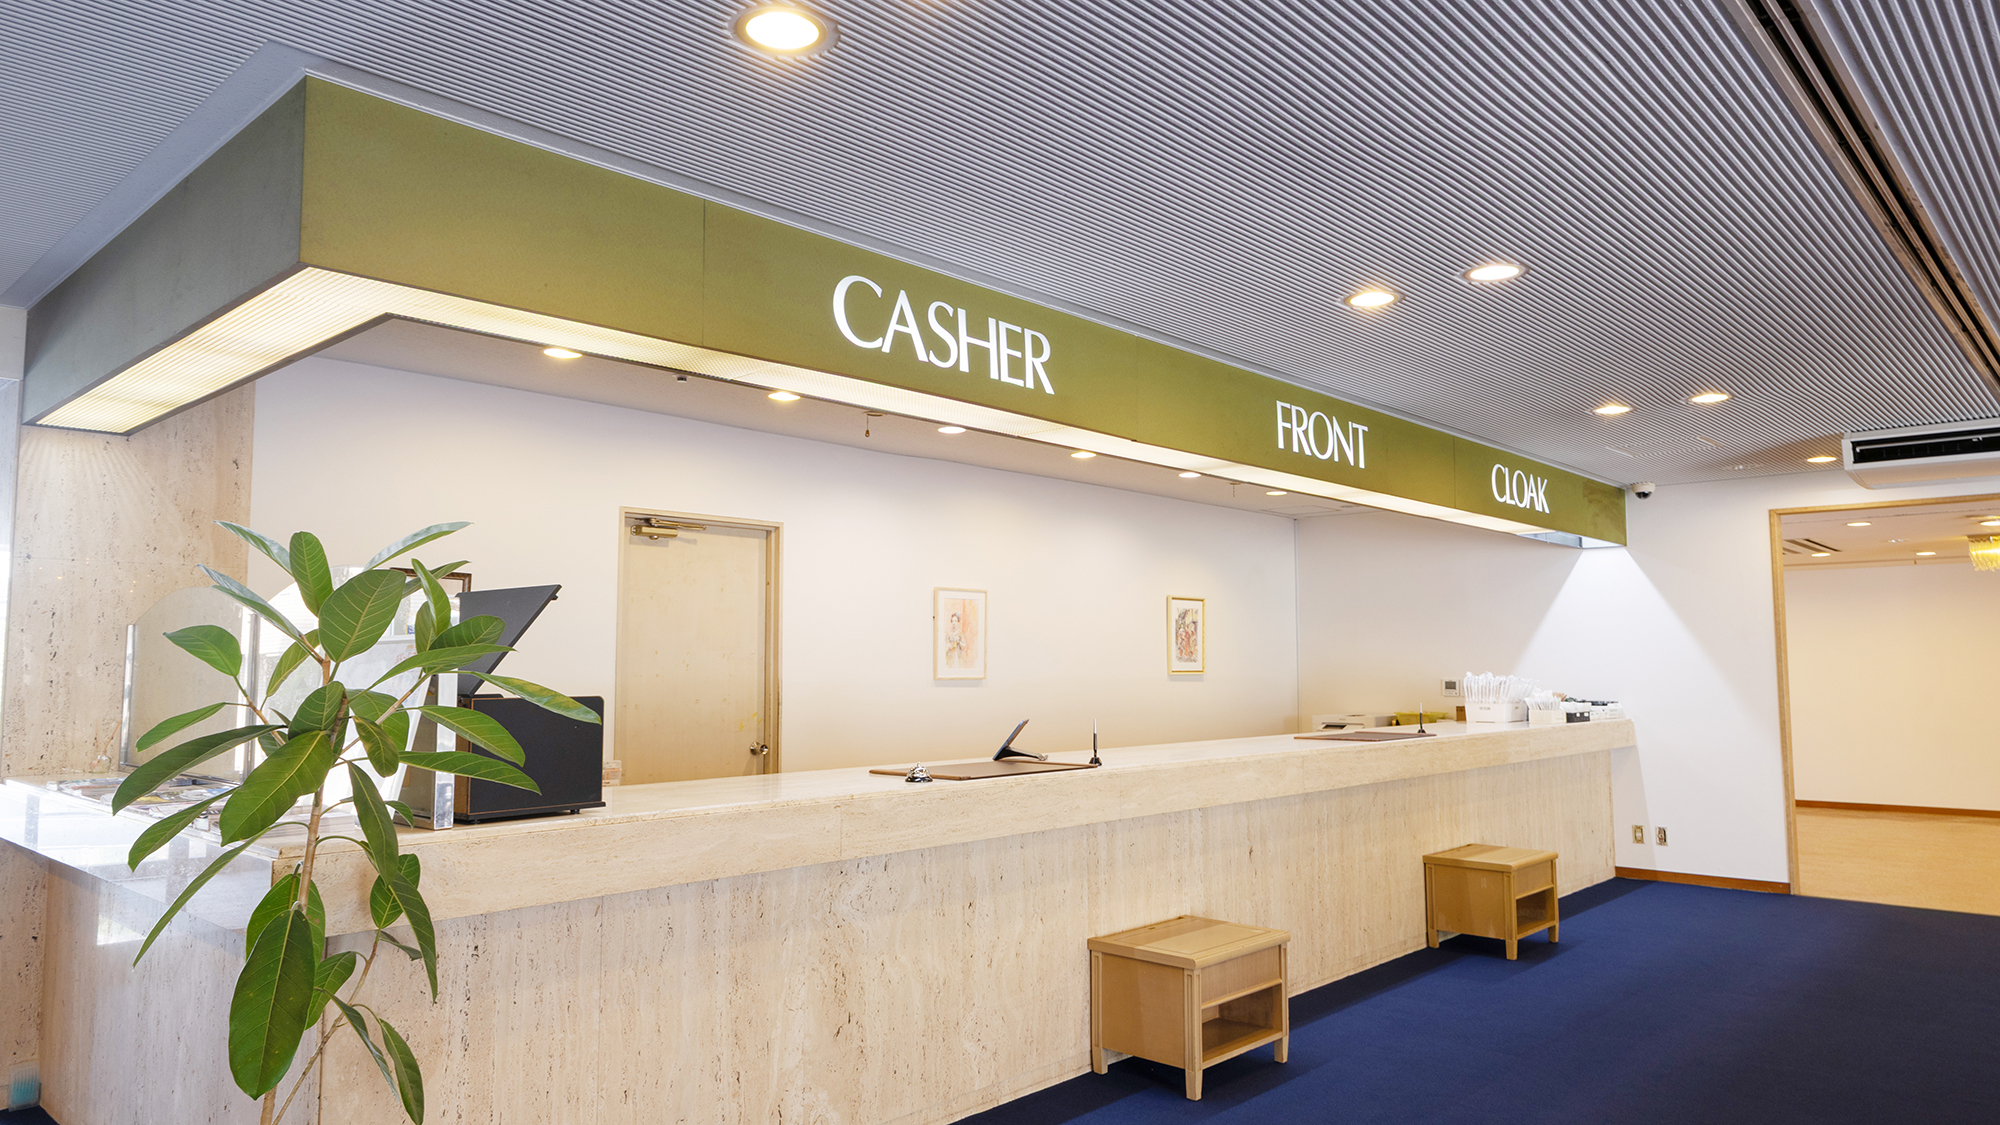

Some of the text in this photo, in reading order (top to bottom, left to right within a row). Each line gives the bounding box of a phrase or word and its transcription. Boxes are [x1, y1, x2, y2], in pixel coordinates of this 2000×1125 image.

[833, 275, 1055, 395] CASHER
[1276, 401, 1368, 469] FRONT
[1491, 464, 1550, 514] CLOAK
